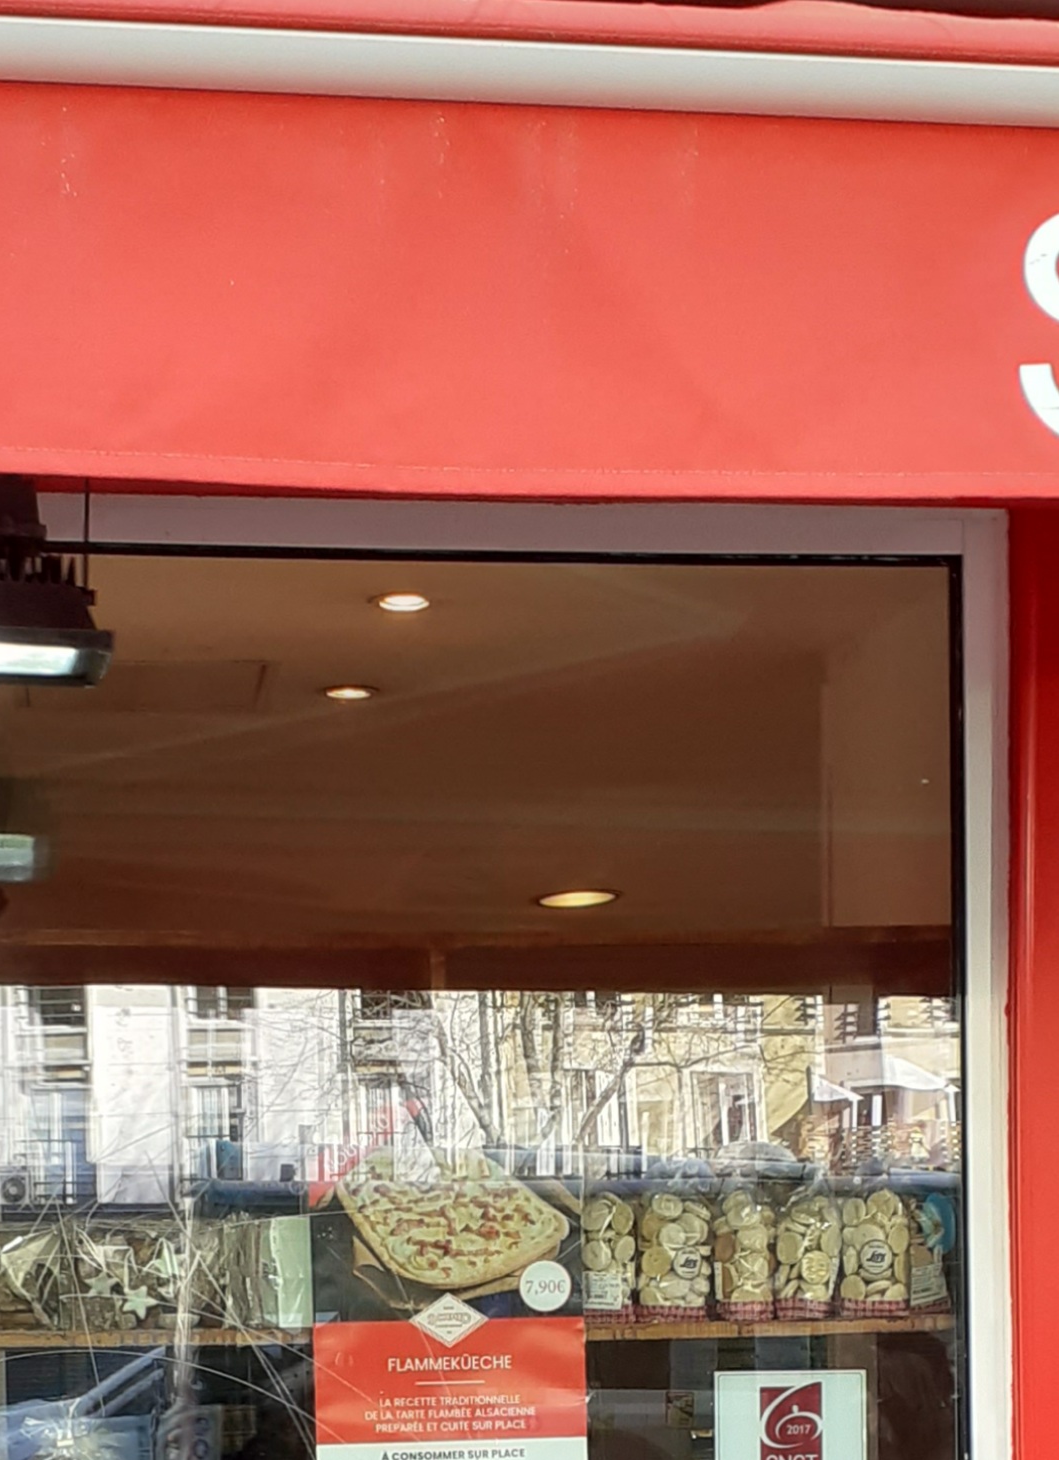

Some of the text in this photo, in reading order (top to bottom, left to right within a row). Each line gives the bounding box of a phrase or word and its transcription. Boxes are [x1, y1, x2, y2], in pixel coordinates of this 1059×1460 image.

[526, 1280, 566, 1295] 7,90€
[388, 1354, 512, 1372] FLAMMEKÜECHE
[380, 1395, 520, 1408] LA RECETTE TRADITIONNELLE
[365, 1407, 536, 1420] DE LA TARTE FLAMBÉE ALSACIENNE
[427, 1422, 438, 1431] ET
[440, 1421, 469, 1431] CUITE
[472, 1421, 492, 1430] SUR
[495, 1420, 526, 1430] PLACE
[786, 1424, 812, 1435] 2017
[392, 1450, 465, 1460] CONSOMMER
[468, 1450, 489, 1460] SUR
[491, 1448, 525, 1458] PLACE
